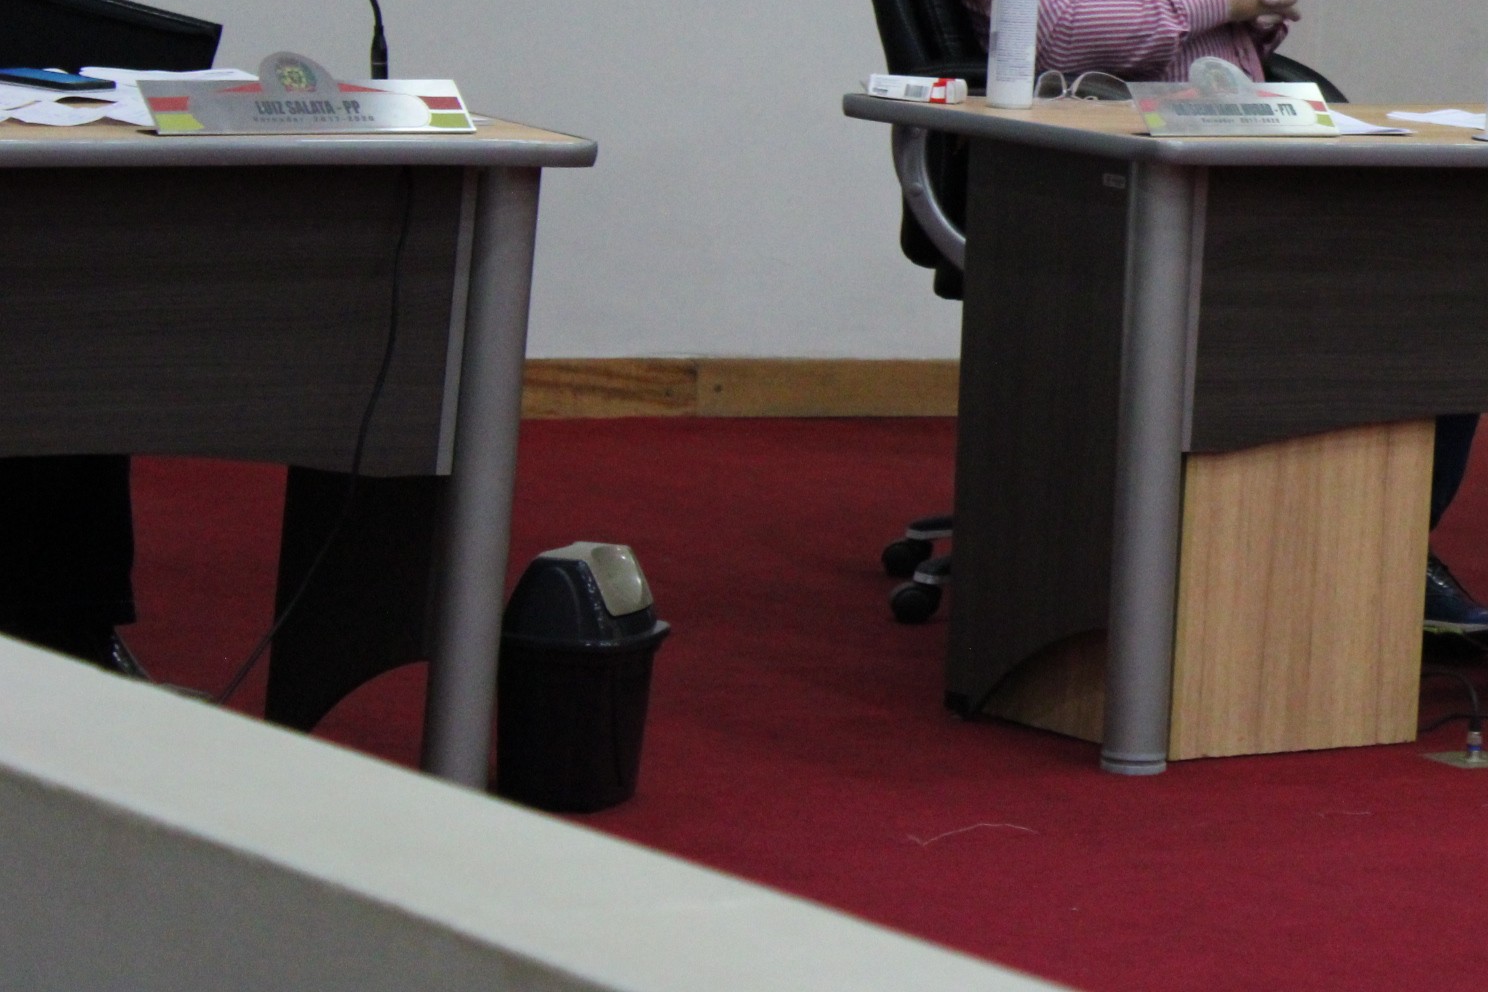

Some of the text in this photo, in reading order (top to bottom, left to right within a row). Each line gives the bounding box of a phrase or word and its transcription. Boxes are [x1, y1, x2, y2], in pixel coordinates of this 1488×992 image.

[255, 100, 286, 115] LUIZ
[286, 100, 336, 115] SALATA
[342, 100, 360, 114] PP
